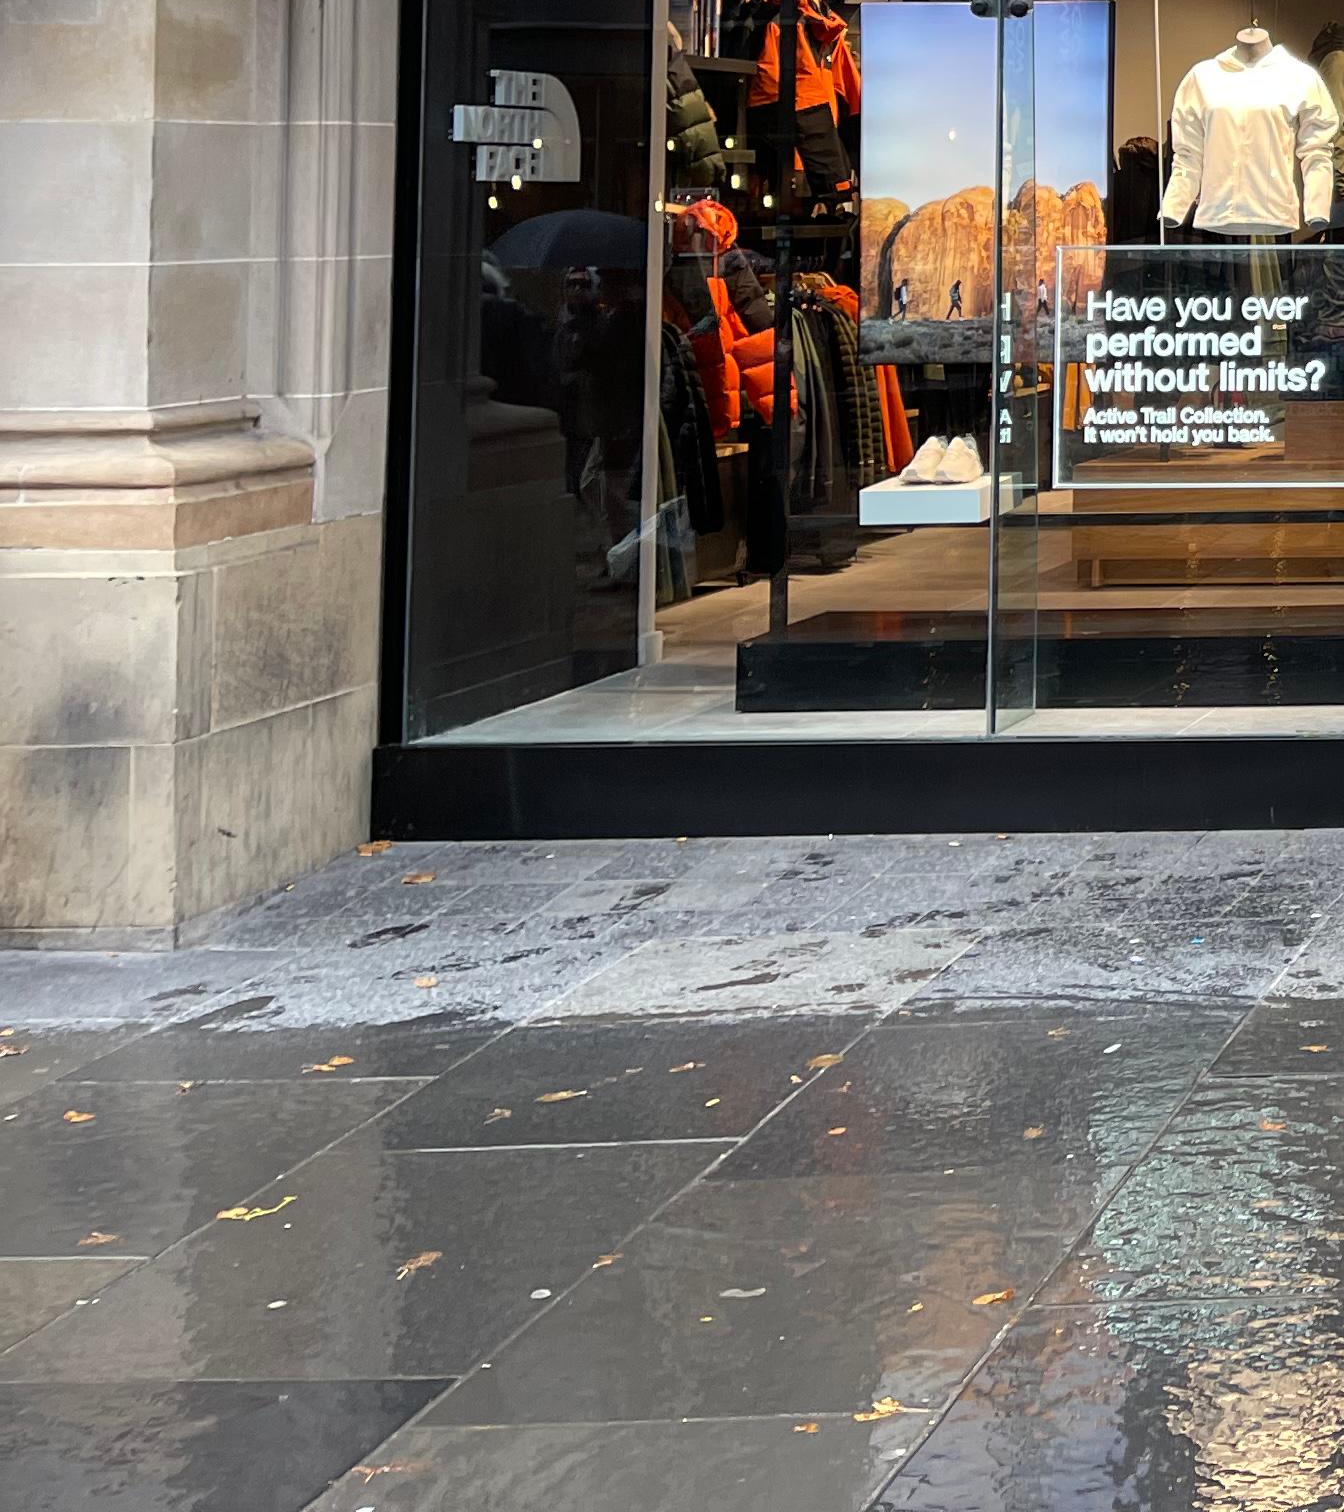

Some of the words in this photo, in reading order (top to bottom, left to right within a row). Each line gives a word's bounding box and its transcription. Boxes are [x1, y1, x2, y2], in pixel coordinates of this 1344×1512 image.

[490, 69, 545, 107] THE
[453, 104, 543, 144] NORTH
[476, 145, 544, 182] FACE
[1086, 290, 1166, 322] Have
[1175, 295, 1232, 328] you
[1241, 295, 1309, 322] ever
[1086, 326, 1262, 364] performed
[1085, 360, 1210, 393] without
[1219, 359, 1327, 393] limits?
[1083, 407, 1138, 425] Active
[1139, 407, 1176, 425] Trail
[1180, 407, 1270, 425] Collection.
[1083, 426, 1097, 443] It
[1098, 426, 1148, 443] won't
[1150, 426, 1188, 443] hold
[1191, 428, 1226, 446] you
[1228, 426, 1275, 443] back.
